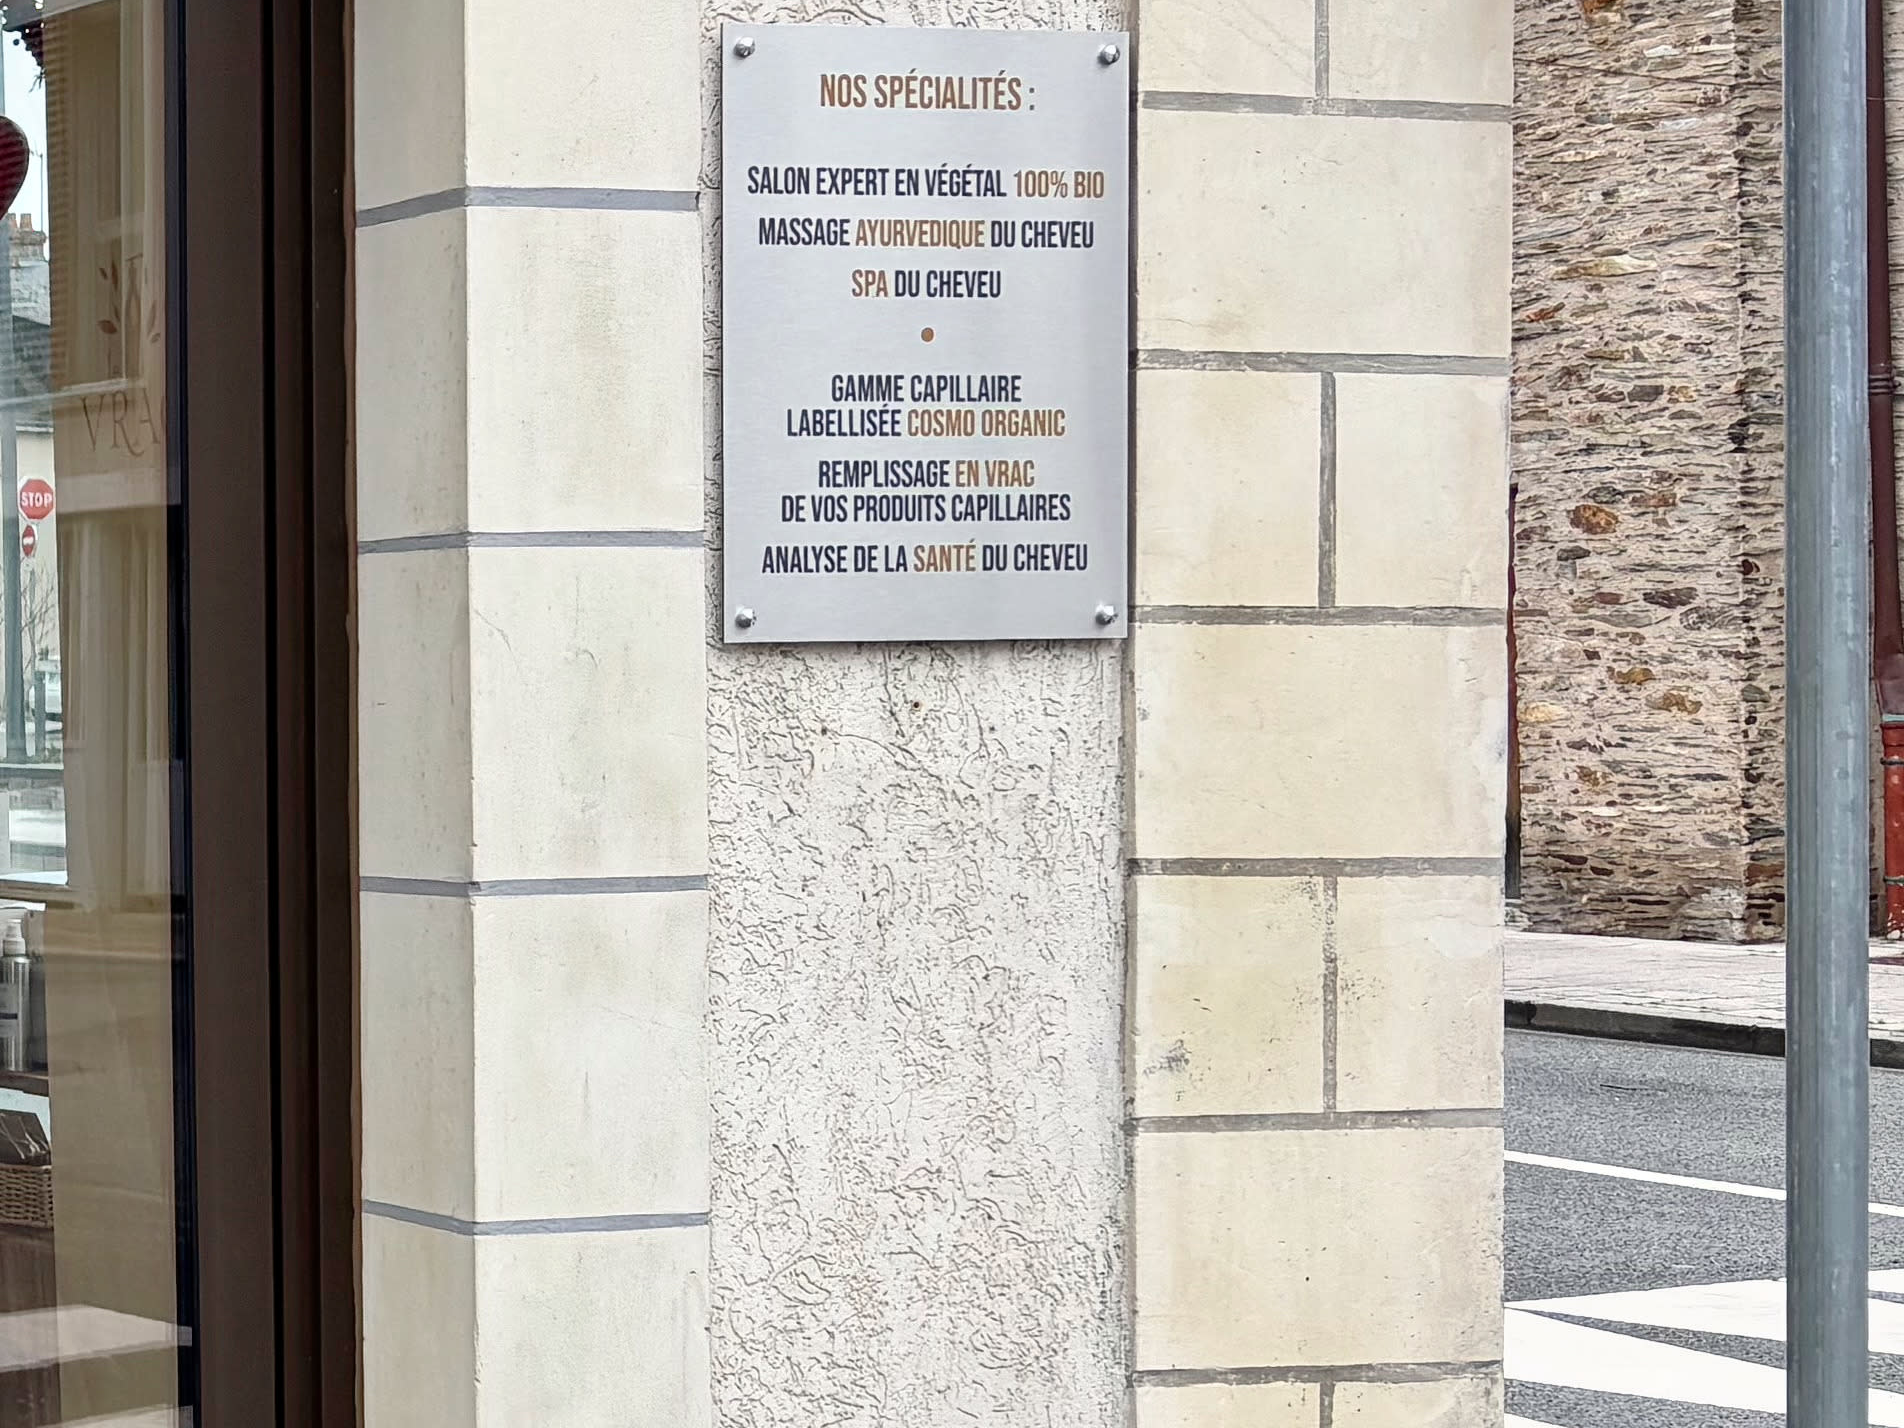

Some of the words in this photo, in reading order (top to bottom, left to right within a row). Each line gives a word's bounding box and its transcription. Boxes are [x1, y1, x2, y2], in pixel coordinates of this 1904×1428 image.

[820, 74, 867, 108] NOS
[874, 68, 1022, 111] SPÉCIALITÉS
[748, 166, 810, 195] SALON
[816, 168, 889, 196] EXPERT
[895, 168, 919, 196] EN
[925, 163, 1007, 197] VÉGÉTAL
[1013, 170, 1068, 198] 100%
[1074, 171, 1105, 199] BIO
[758, 218, 851, 246] MASSAGE
[855, 219, 985, 250] AYURVEDIQUE
[991, 220, 1016, 248] DU
[1021, 220, 1094, 249] CHEVEU
[851, 269, 888, 298] SPA
[894, 270, 920, 298] DU
[926, 271, 1001, 298] CHEVEU
[831, 374, 904, 402] GAMME
[910, 375, 1022, 402] CAPILLAIRE
[80, 388, 166, 458] VRA
[787, 403, 902, 437] LABELLISÉE
[907, 409, 975, 437] COSMO
[981, 409, 1066, 437] ORGANIC
[818, 460, 950, 488] REMPLISSAGE
[955, 460, 979, 487] EN
[984, 460, 1035, 487] VRAC
[21, 492, 52, 507] STOP
[781, 494, 806, 523] DE
[811, 494, 848, 522] VOS
[853, 494, 946, 522] PRODUITS
[951, 494, 1071, 522] CAPILLAIRES
[762, 545, 847, 574] ANALYSE
[854, 545, 878, 573] DE
[884, 545, 908, 573] LA
[913, 539, 976, 573] SANTÉ
[982, 544, 1008, 572] DU
[1013, 544, 1088, 571] CHEVEU
